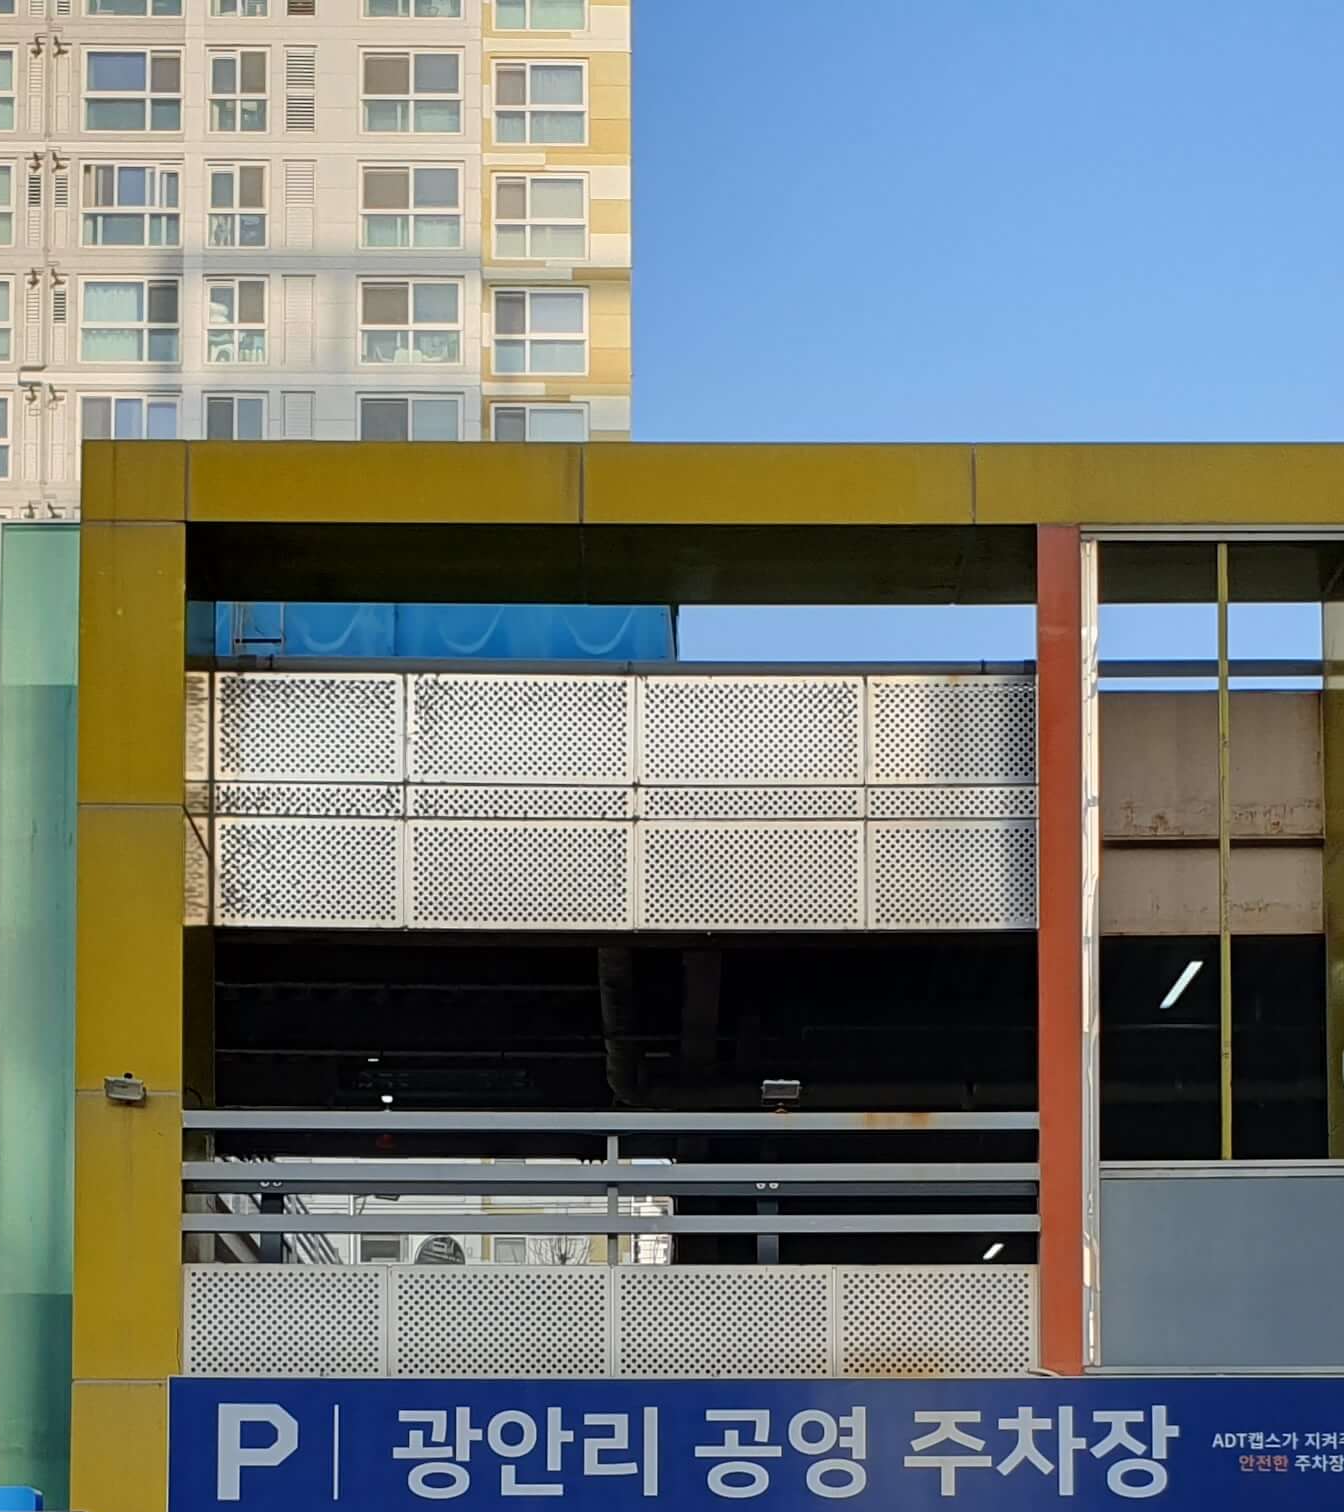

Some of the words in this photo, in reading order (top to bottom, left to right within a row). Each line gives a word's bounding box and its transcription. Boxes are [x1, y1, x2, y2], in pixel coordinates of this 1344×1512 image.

[1212, 1432, 1299, 1450] ADT캡스가
[218, 1404, 299, 1500] P
[393, 1406, 659, 1499] 광안리
[695, 1406, 868, 1499] 공영
[904, 1405, 1180, 1498] 주차장
[1239, 1455, 1289, 1472] 안전한
